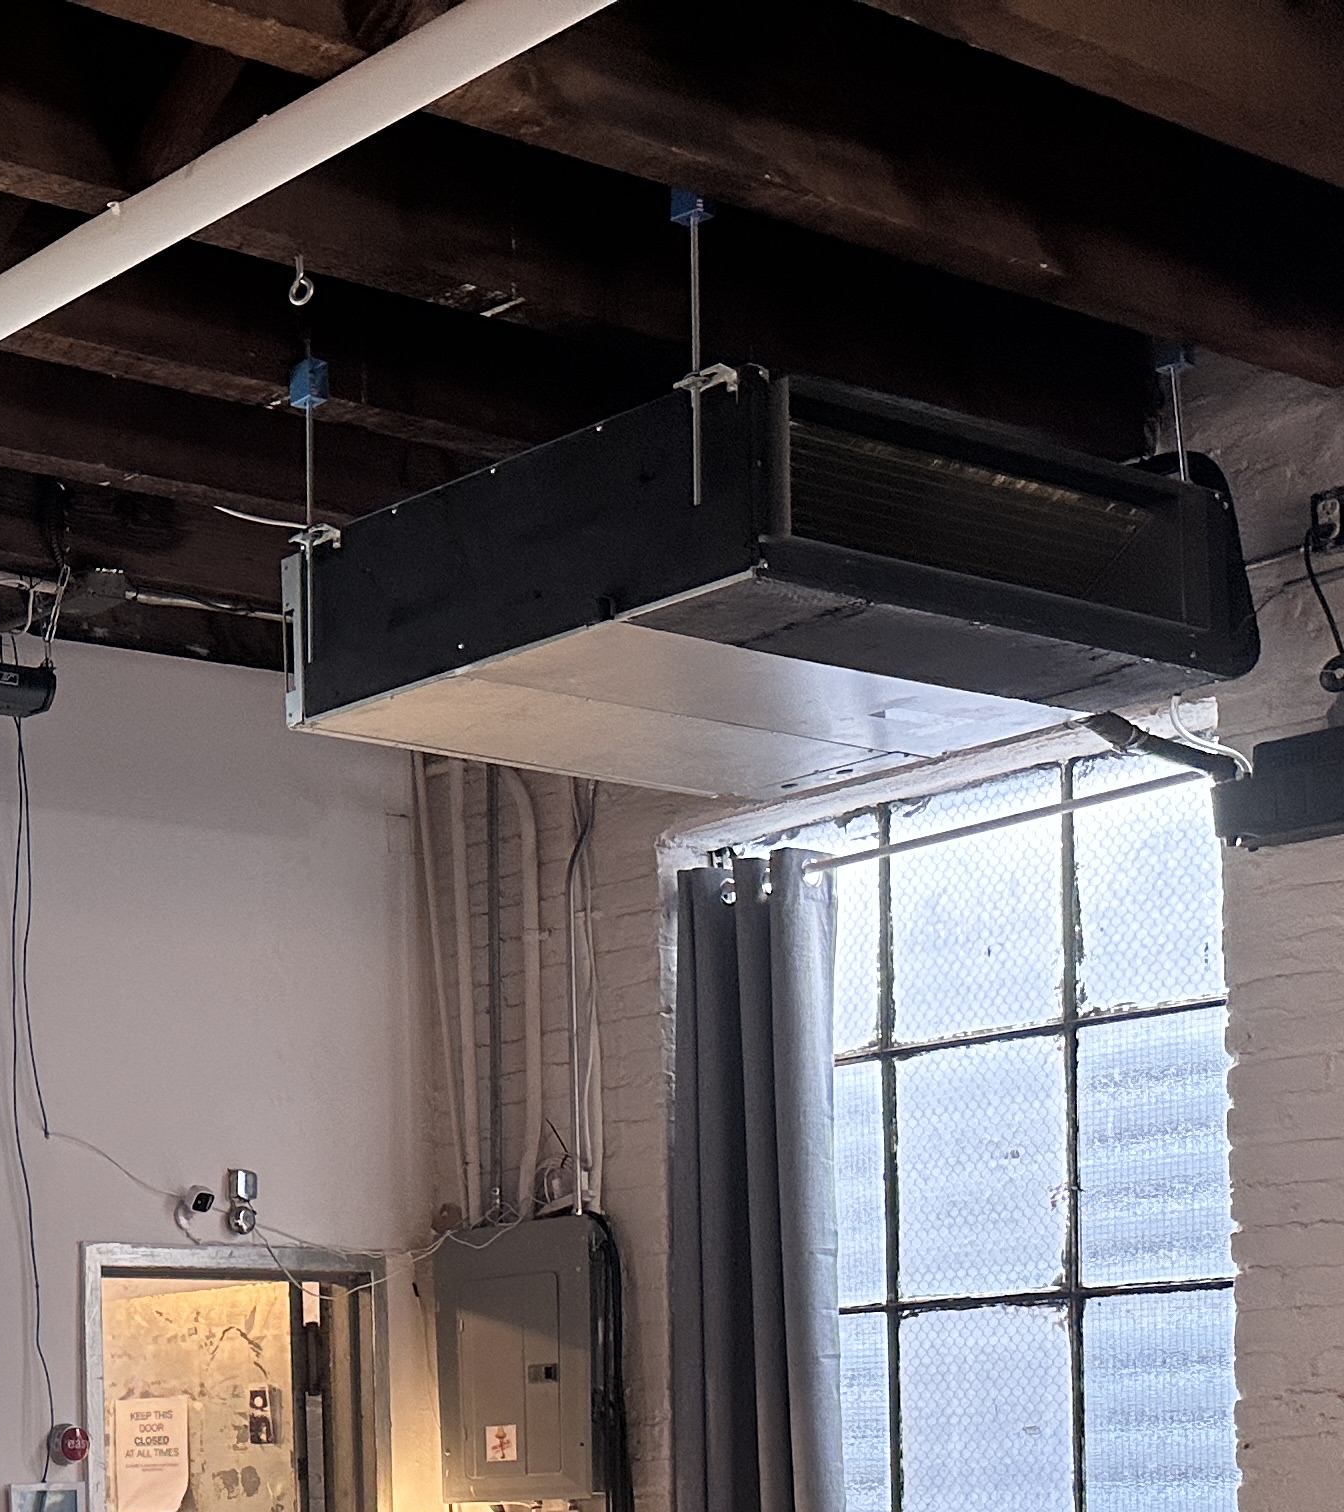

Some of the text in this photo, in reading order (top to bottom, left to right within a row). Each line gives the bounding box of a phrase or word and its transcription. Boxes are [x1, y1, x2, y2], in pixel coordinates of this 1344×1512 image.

[130, 1410, 173, 1421] KEEP THIS
[139, 1423, 164, 1433] DOOR
[134, 1435, 169, 1446] CLOSED
[125, 1447, 180, 1458] AT ALL TIMES
